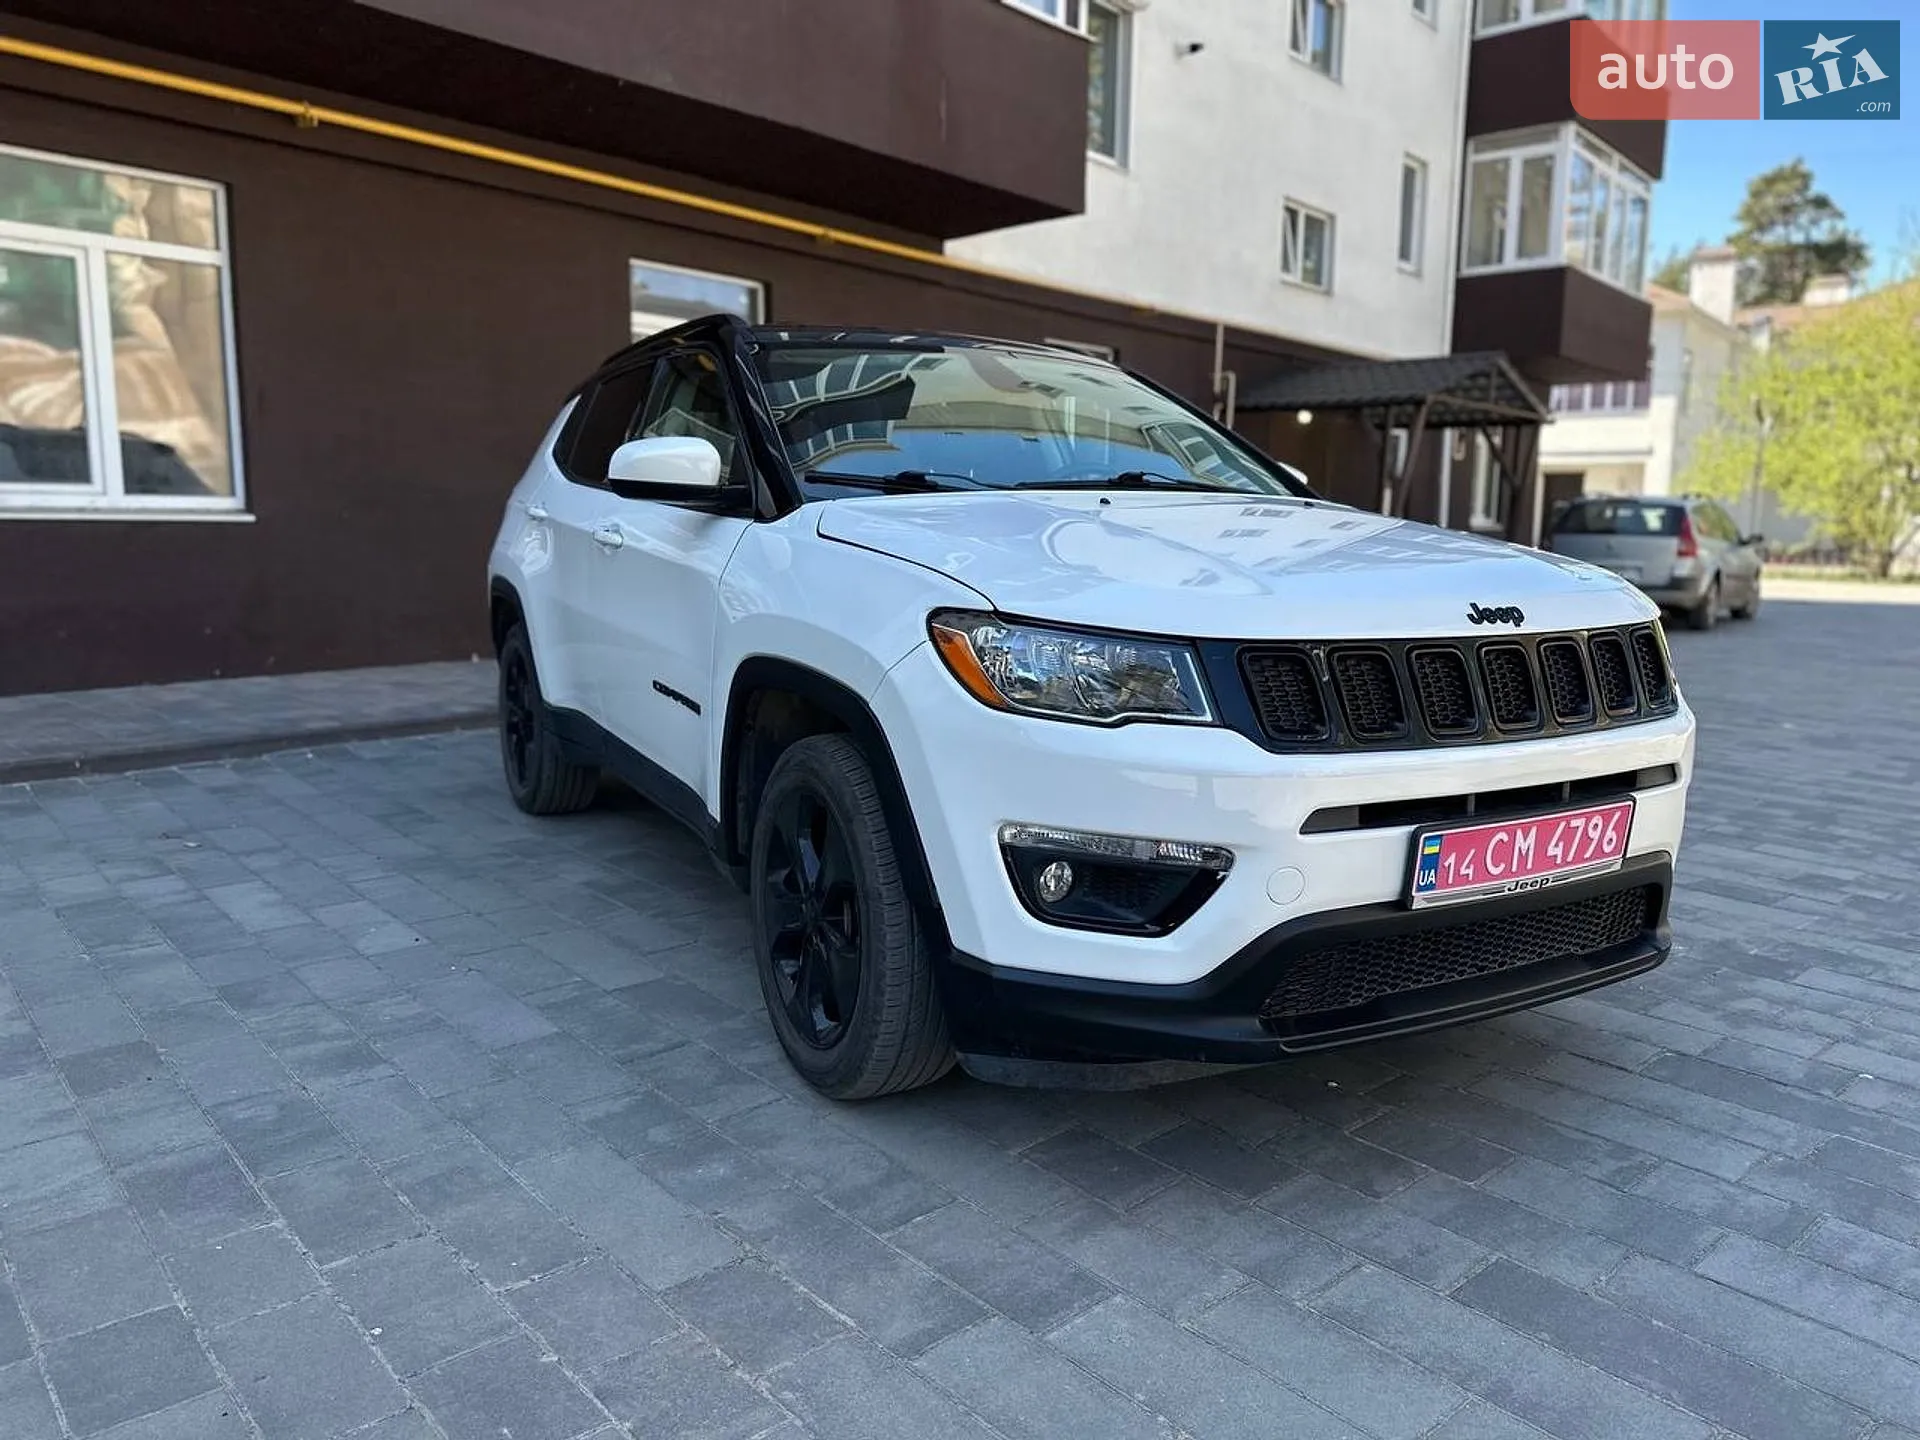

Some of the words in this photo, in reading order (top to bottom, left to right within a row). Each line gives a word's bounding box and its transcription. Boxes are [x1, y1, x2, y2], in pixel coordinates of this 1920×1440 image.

[1466, 602, 1525, 628] Jeep
[1443, 849, 1476, 884] 14
[1484, 825, 1537, 876] CM
[1547, 811, 1622, 864] 4796
[1419, 868, 1436, 887] UA
